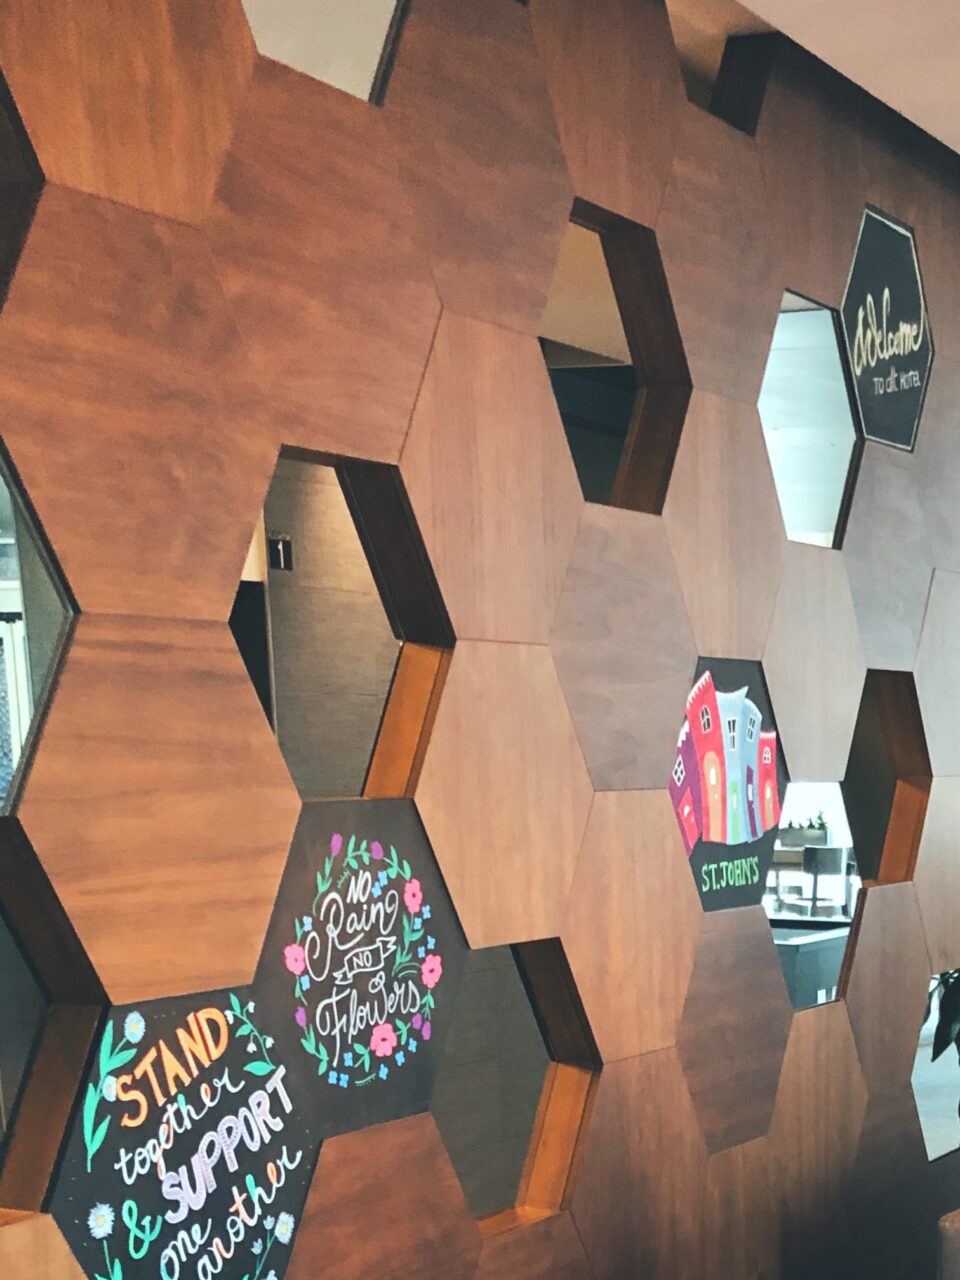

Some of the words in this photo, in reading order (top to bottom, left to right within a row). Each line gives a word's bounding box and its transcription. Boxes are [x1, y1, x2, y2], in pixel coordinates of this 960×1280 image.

[853, 287, 923, 376] Welcome
[873, 377, 884, 395] TO
[346, 869, 371, 905] NO
[305, 890, 398, 982] Rain
[353, 951, 372, 968] NO
[316, 971, 421, 1067] Flowers
[115, 1007, 229, 1127] STAND
[115, 1068, 245, 1185] together
[122, 1200, 162, 1259] &
[162, 1065, 293, 1224] SUPPORT
